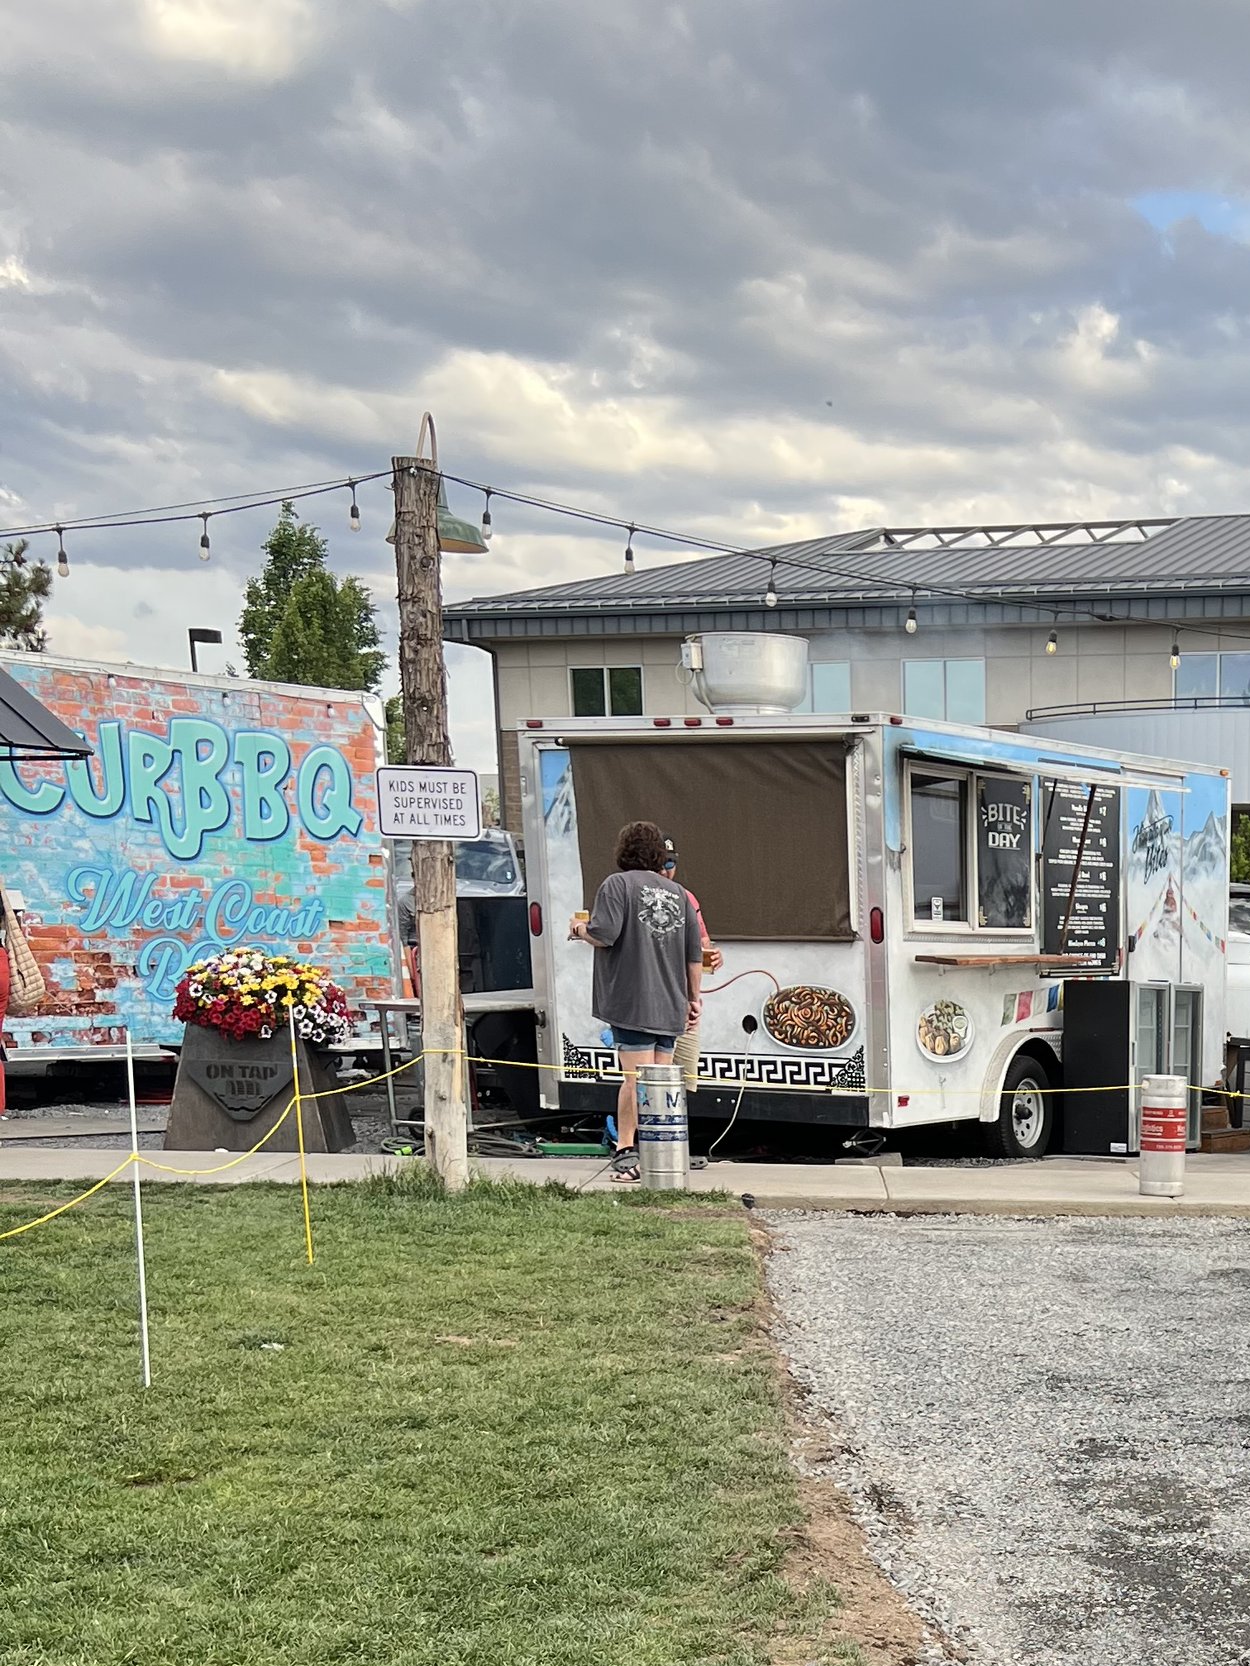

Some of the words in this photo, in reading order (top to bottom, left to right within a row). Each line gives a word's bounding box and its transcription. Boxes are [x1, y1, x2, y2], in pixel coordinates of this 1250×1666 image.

[388, 780, 415, 793] KIDS
[419, 781, 448, 794] MUST
[452, 782, 467, 795] BE
[393, 796, 463, 810] SUPERVISED
[393, 812, 405, 824] AT
[409, 813, 430, 825] ALL
[433, 813, 466, 826] TIMES
[988, 803, 1021, 825] BITE
[988, 831, 1021, 848] DAY
[67, 866, 205, 934] West
[204, 879, 325, 946] Coast
[205, 1064, 234, 1079] ON
[238, 1064, 278, 1080] TAP
